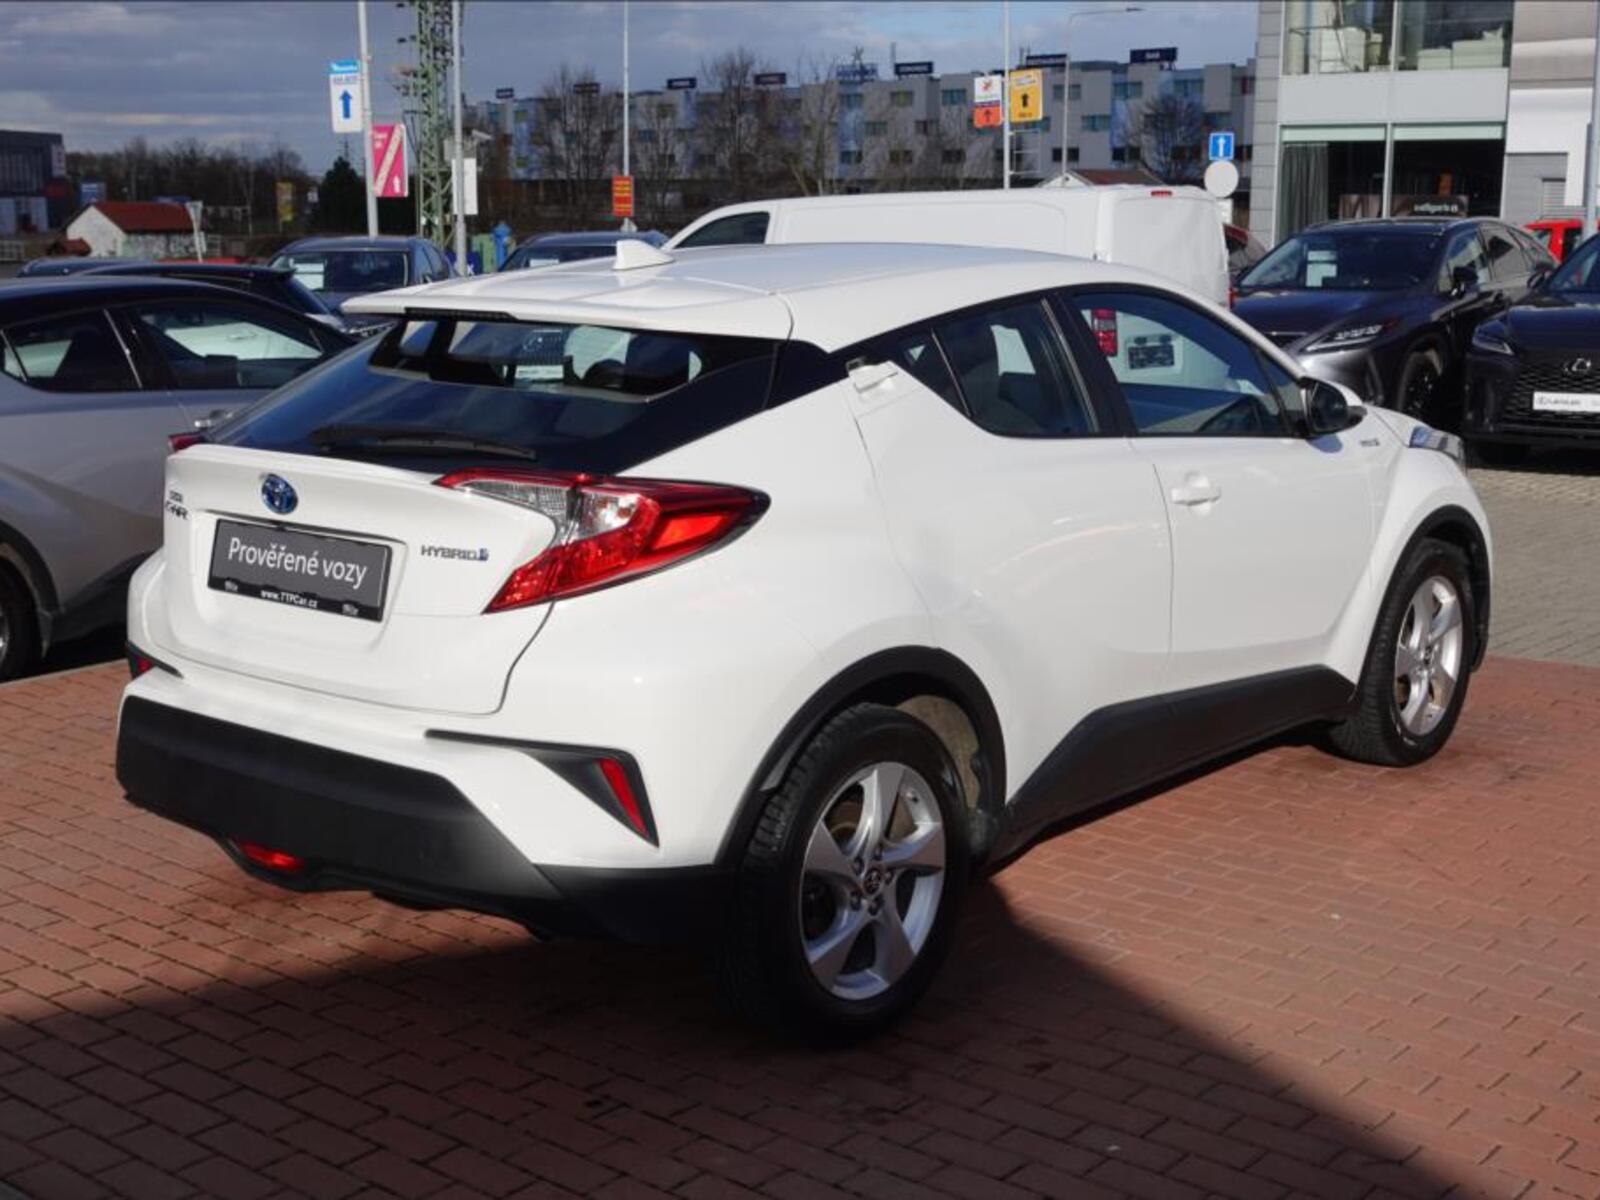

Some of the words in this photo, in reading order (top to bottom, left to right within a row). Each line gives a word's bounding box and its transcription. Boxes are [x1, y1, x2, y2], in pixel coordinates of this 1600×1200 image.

[420, 543, 478, 561] HYBRID
[227, 536, 320, 577] Prověřené
[322, 558, 368, 590] vozy
[259, 589, 319, 609] www.TTPCar.cz
